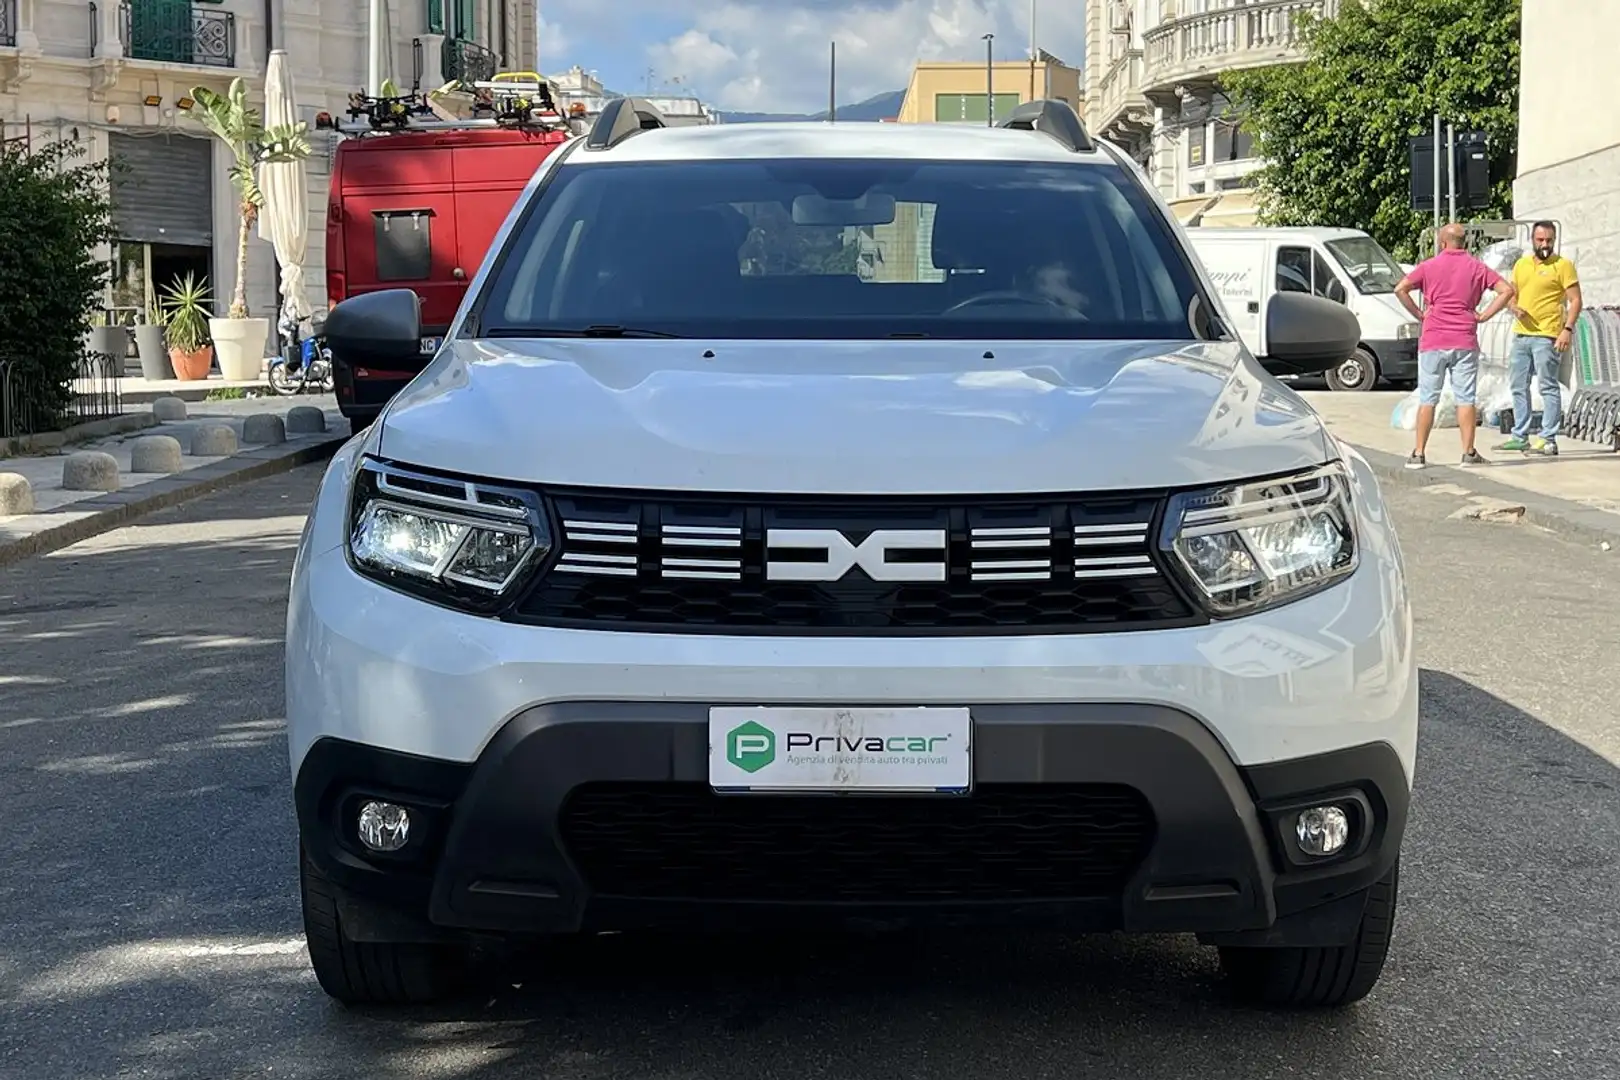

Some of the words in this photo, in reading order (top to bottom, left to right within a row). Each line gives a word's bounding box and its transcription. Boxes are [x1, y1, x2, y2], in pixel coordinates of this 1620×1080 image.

[1204, 265, 1252, 287] ampi
[787, 733, 948, 752] Privacar
[787, 755, 826, 765] Agenzia
[827, 754, 837, 764] di
[839, 755, 876, 764] vendita
[877, 756, 901, 764] auto
[902, 756, 916, 764] tra
[917, 755, 948, 766] privati
